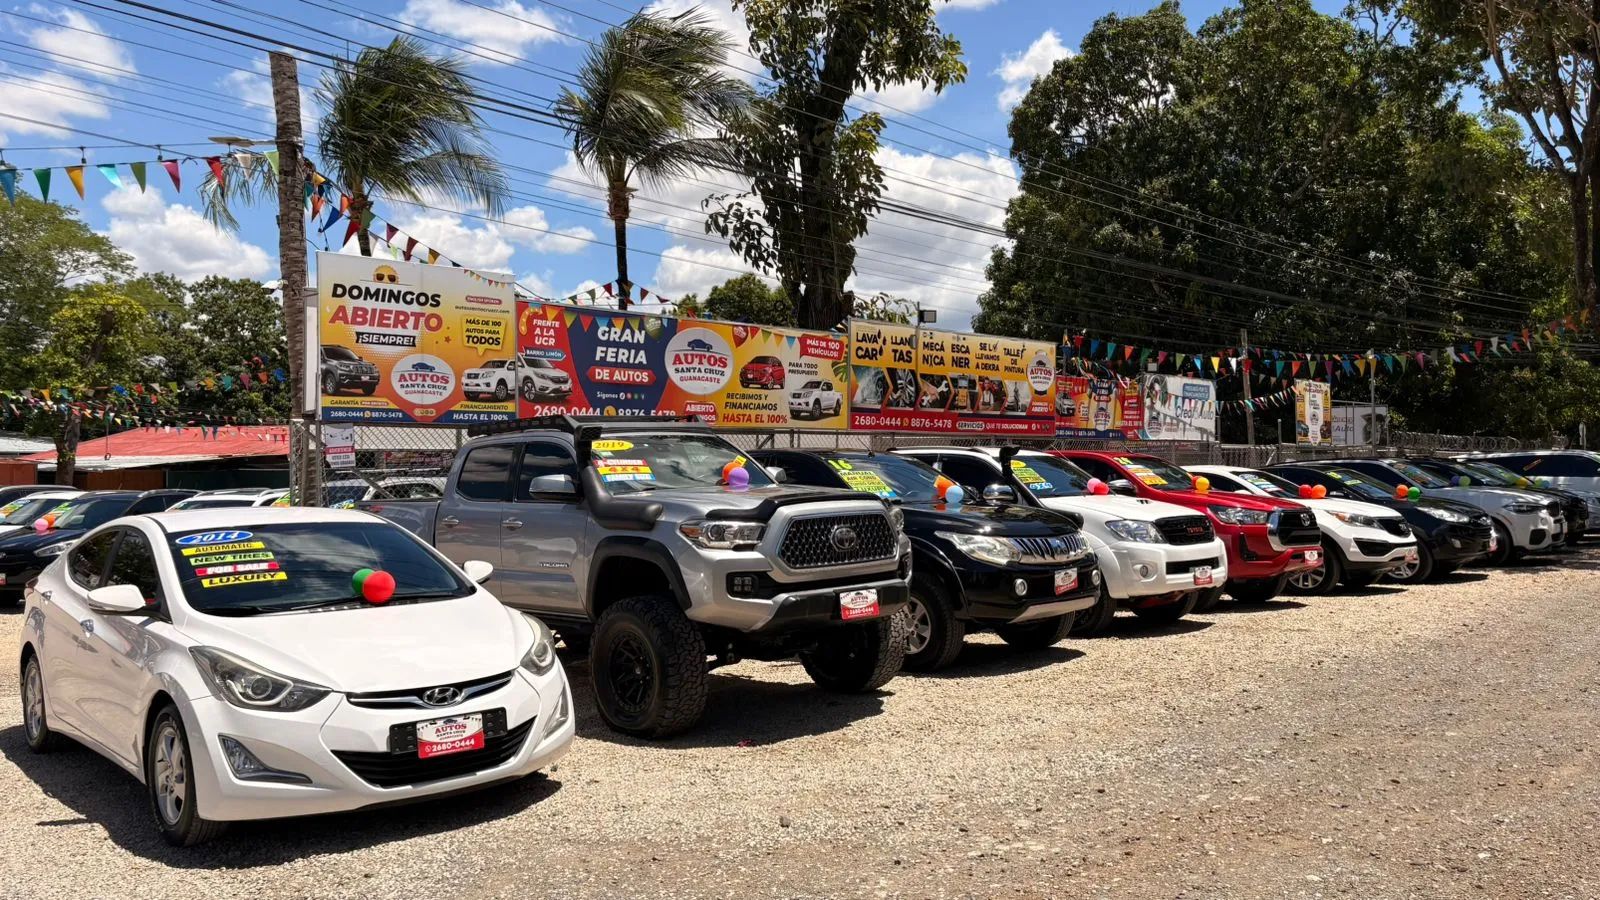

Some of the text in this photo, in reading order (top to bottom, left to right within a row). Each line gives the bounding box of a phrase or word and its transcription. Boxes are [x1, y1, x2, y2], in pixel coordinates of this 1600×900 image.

[331, 283, 441, 308] DOMINGOS
[329, 304, 443, 332] ABIERTO
[533, 319, 560, 328] FRENTE
[358, 334, 414, 346] ¡SIEMPRE!
[466, 335, 500, 346] TODOS
[597, 326, 646, 344] GRAN
[856, 332, 879, 344] LAVA
[535, 337, 555, 346] UCR
[828, 341, 840, 350] 100
[923, 341, 945, 352] MECÁ
[979, 342, 987, 351] SE
[856, 346, 878, 360] CAR
[951, 343, 970, 354] ESCA
[595, 346, 647, 364] FERIA
[672, 353, 728, 368] AUTOS
[892, 349, 912, 363] TAS
[922, 354, 945, 366] NICA
[951, 355, 970, 368] NER
[595, 369, 649, 382] DE AUTOS
[704, 368, 725, 376] CRUZ
[1004, 366, 1024, 374] PINTURA
[1030, 367, 1052, 376] AUTOS
[398, 373, 450, 384] AUTOS
[534, 405, 600, 416] 2680-0444
[686, 404, 715, 412] ABIERTO
[724, 402, 778, 411] FINANCIAMOS
[452, 412, 479, 420] HASTA
[722, 413, 788, 423] HASTA EL 100%
[855, 416, 952, 428] 2680-0444 8876-5478
[191, 531, 238, 544] 2014
[194, 543, 252, 553] AUTOMATIC
[194, 556, 227, 564] NEW
[236, 562, 268, 571] SALE
[209, 572, 278, 585] LUXURY
[434, 724, 467, 734] AUTOS
[432, 738, 475, 752] 2680-0444
